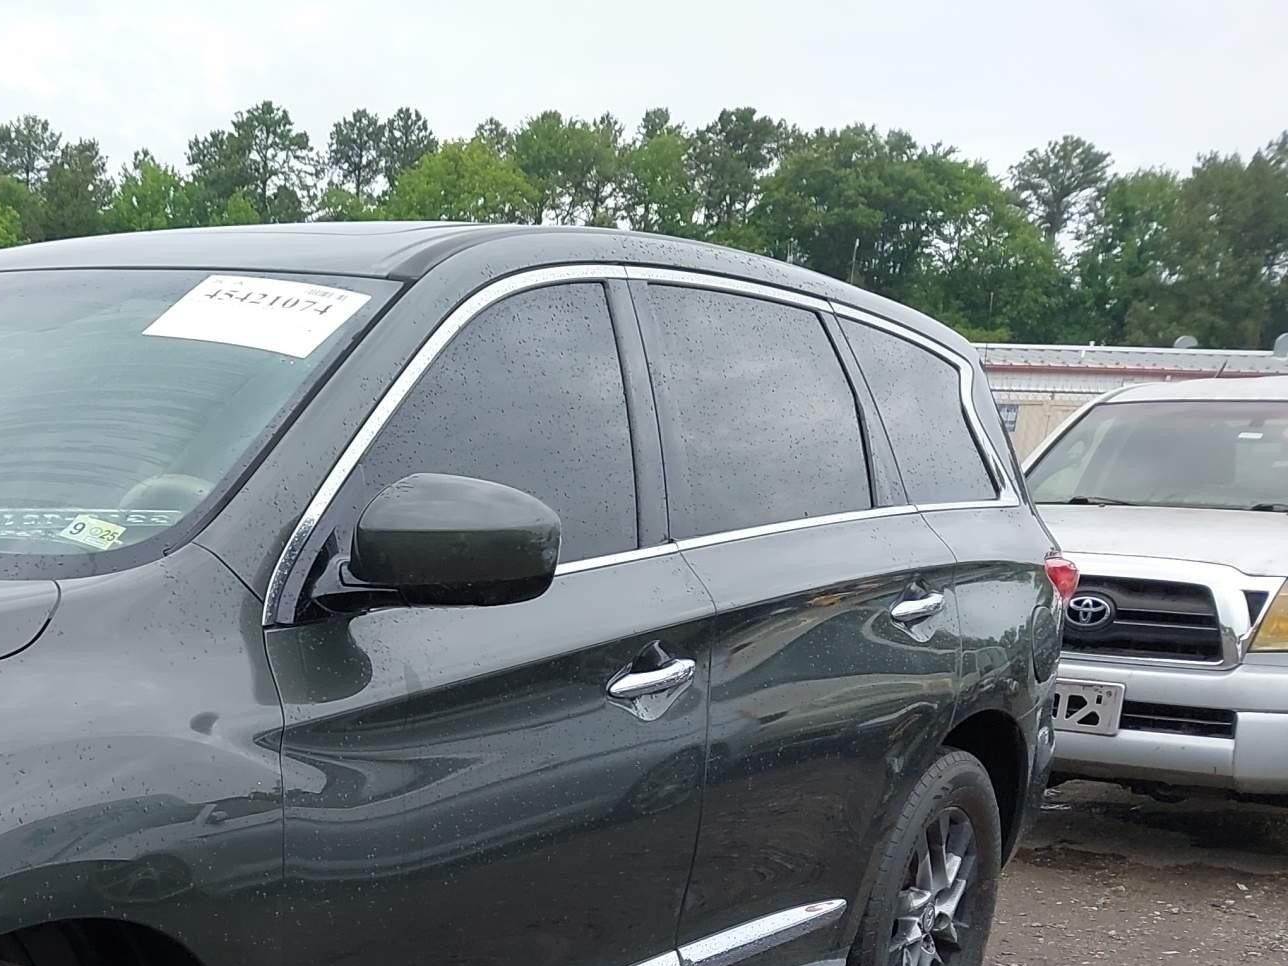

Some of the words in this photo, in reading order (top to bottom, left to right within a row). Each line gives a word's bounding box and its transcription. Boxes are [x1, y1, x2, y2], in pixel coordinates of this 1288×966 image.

[203, 288, 334, 315] 45421074
[69, 521, 87, 536] 9
[100, 528, 119, 543] 25
